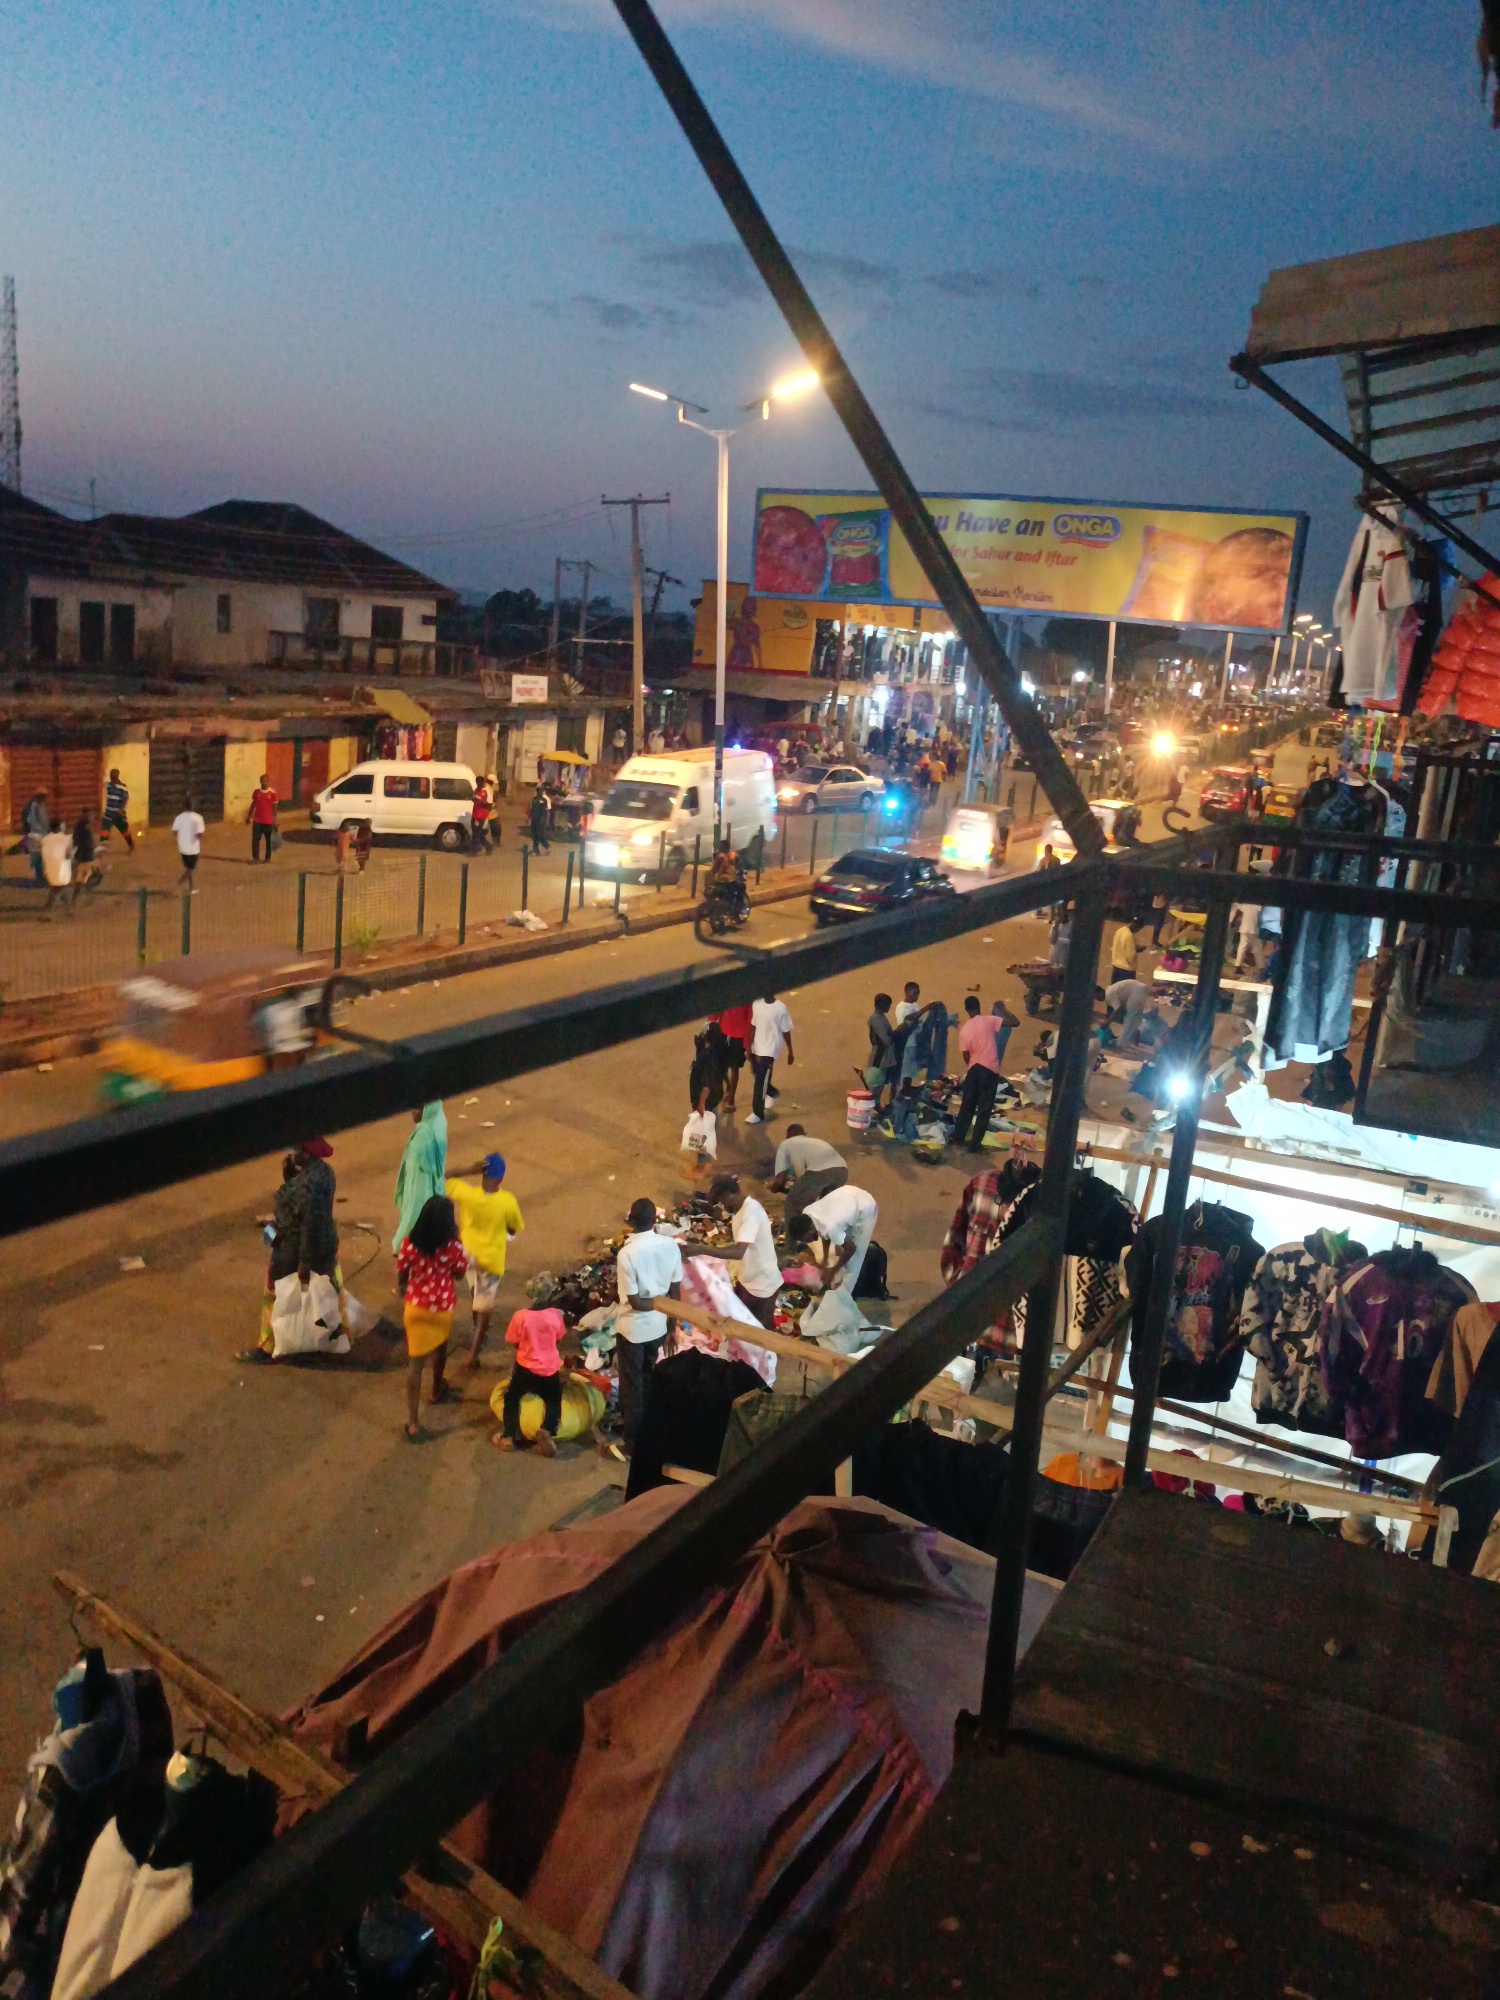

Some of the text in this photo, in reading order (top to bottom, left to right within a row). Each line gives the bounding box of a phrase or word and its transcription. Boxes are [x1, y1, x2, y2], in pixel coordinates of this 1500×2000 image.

[955, 511, 1011, 534] Have
[1015, 518, 1045, 536] an
[1056, 516, 1115, 536] ONGA
[1014, 551, 1041, 564] and
[1393, 1318, 1425, 1360] 16
